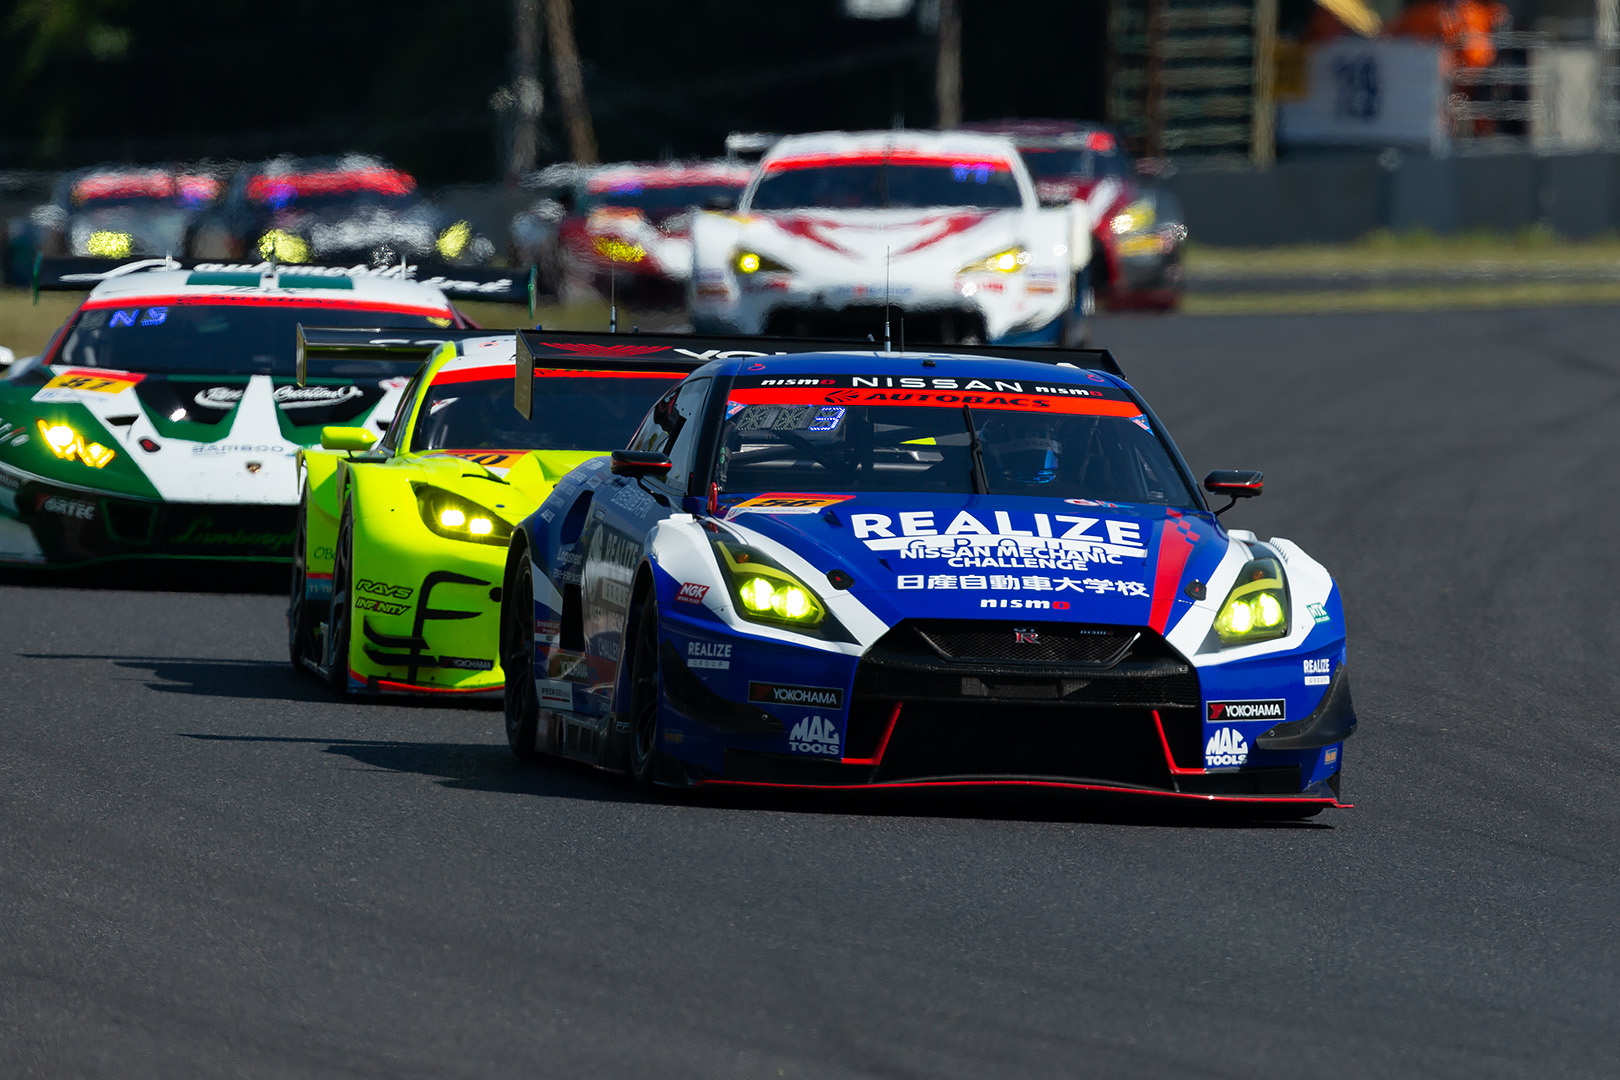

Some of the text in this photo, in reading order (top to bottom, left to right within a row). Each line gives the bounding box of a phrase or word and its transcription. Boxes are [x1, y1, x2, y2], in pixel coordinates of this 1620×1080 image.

[761, 376, 1104, 397] nismo NISSAN nismo
[862, 392, 1051, 408] AUTOBACS
[850, 510, 1144, 547] REALIZE
[899, 546, 1124, 565] NISSAN MECHANIC
[947, 557, 1089, 572] CHALLENGE
[356, 580, 414, 599] RAYS
[680, 584, 707, 598] NGK
[896, 574, 1150, 598] 日産自動車大学校
[980, 598, 1071, 610] nismo
[687, 641, 732, 658] REALIZE
[1303, 659, 1330, 674] REALIZE
[773, 688, 838, 705] YOKOHAMA
[1225, 704, 1281, 717] YOKOHAMA
[789, 715, 841, 744] MAC
[788, 741, 840, 755] TOOLS
[1205, 727, 1249, 755] MAC
[1205, 755, 1249, 766] TOOLS
